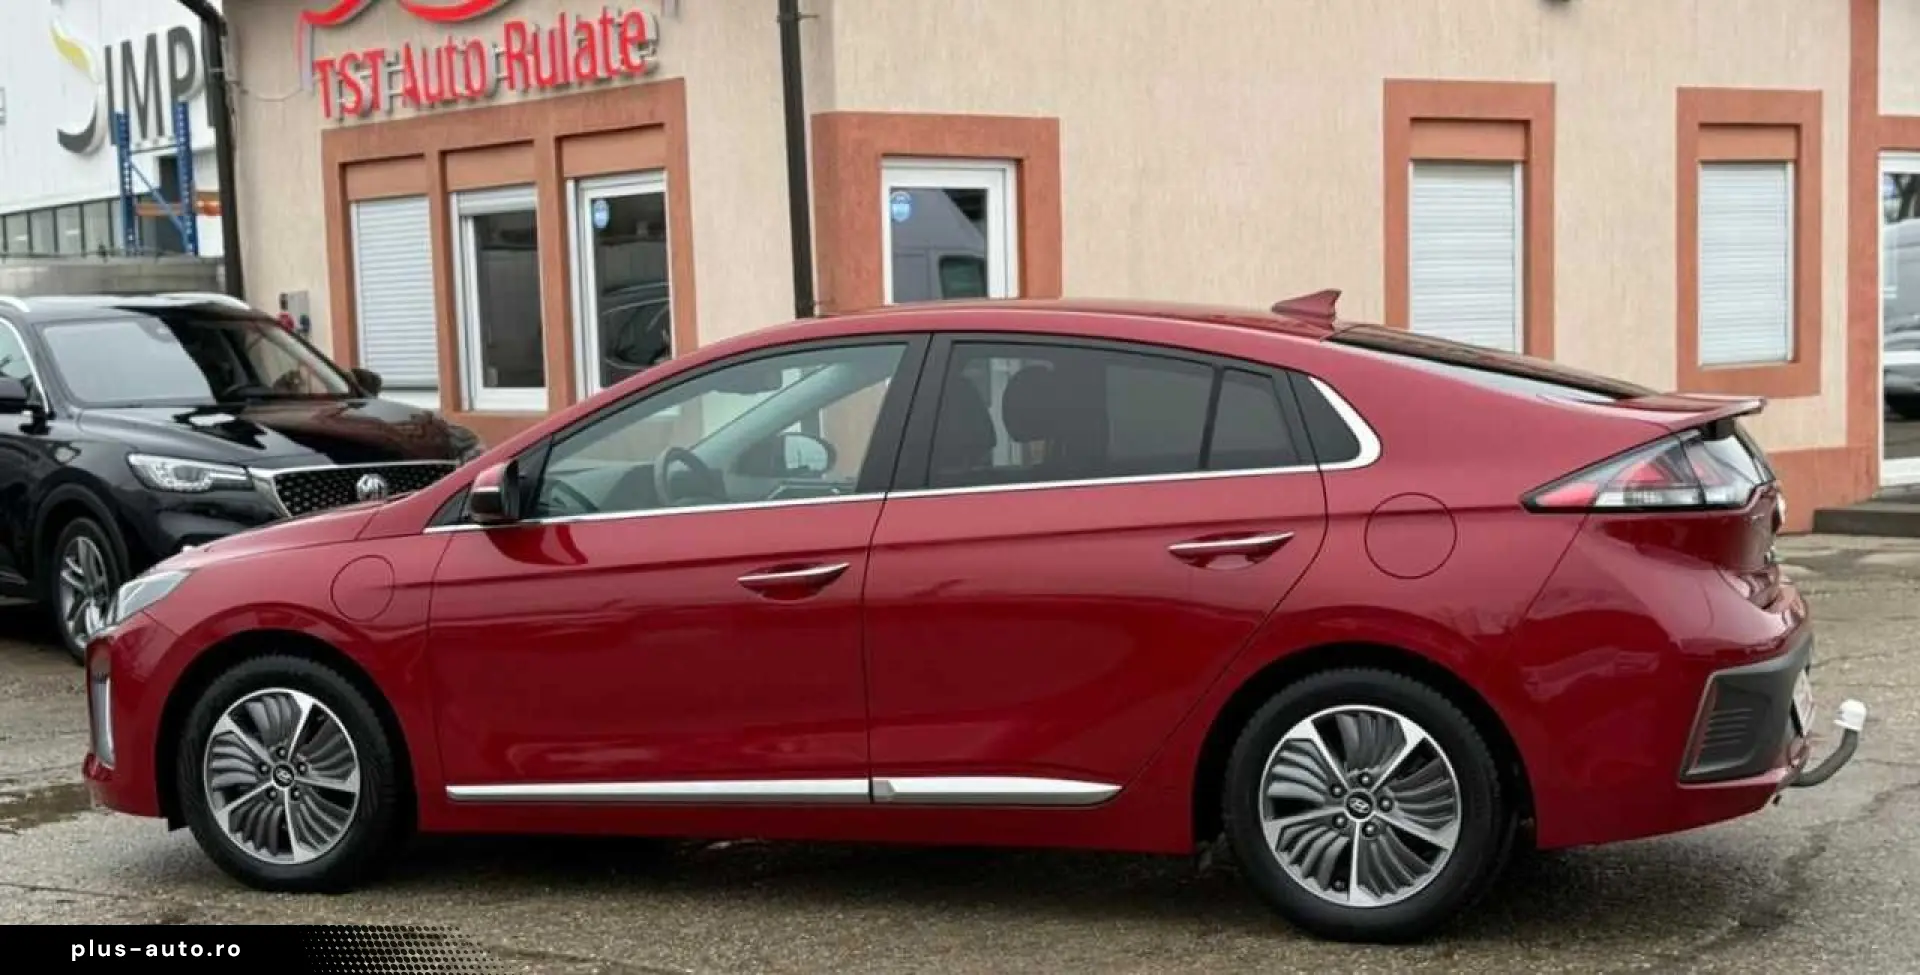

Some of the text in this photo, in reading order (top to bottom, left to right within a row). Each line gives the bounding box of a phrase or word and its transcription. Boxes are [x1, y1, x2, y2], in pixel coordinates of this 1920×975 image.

[312, 9, 648, 120] TST Auto Rulate
